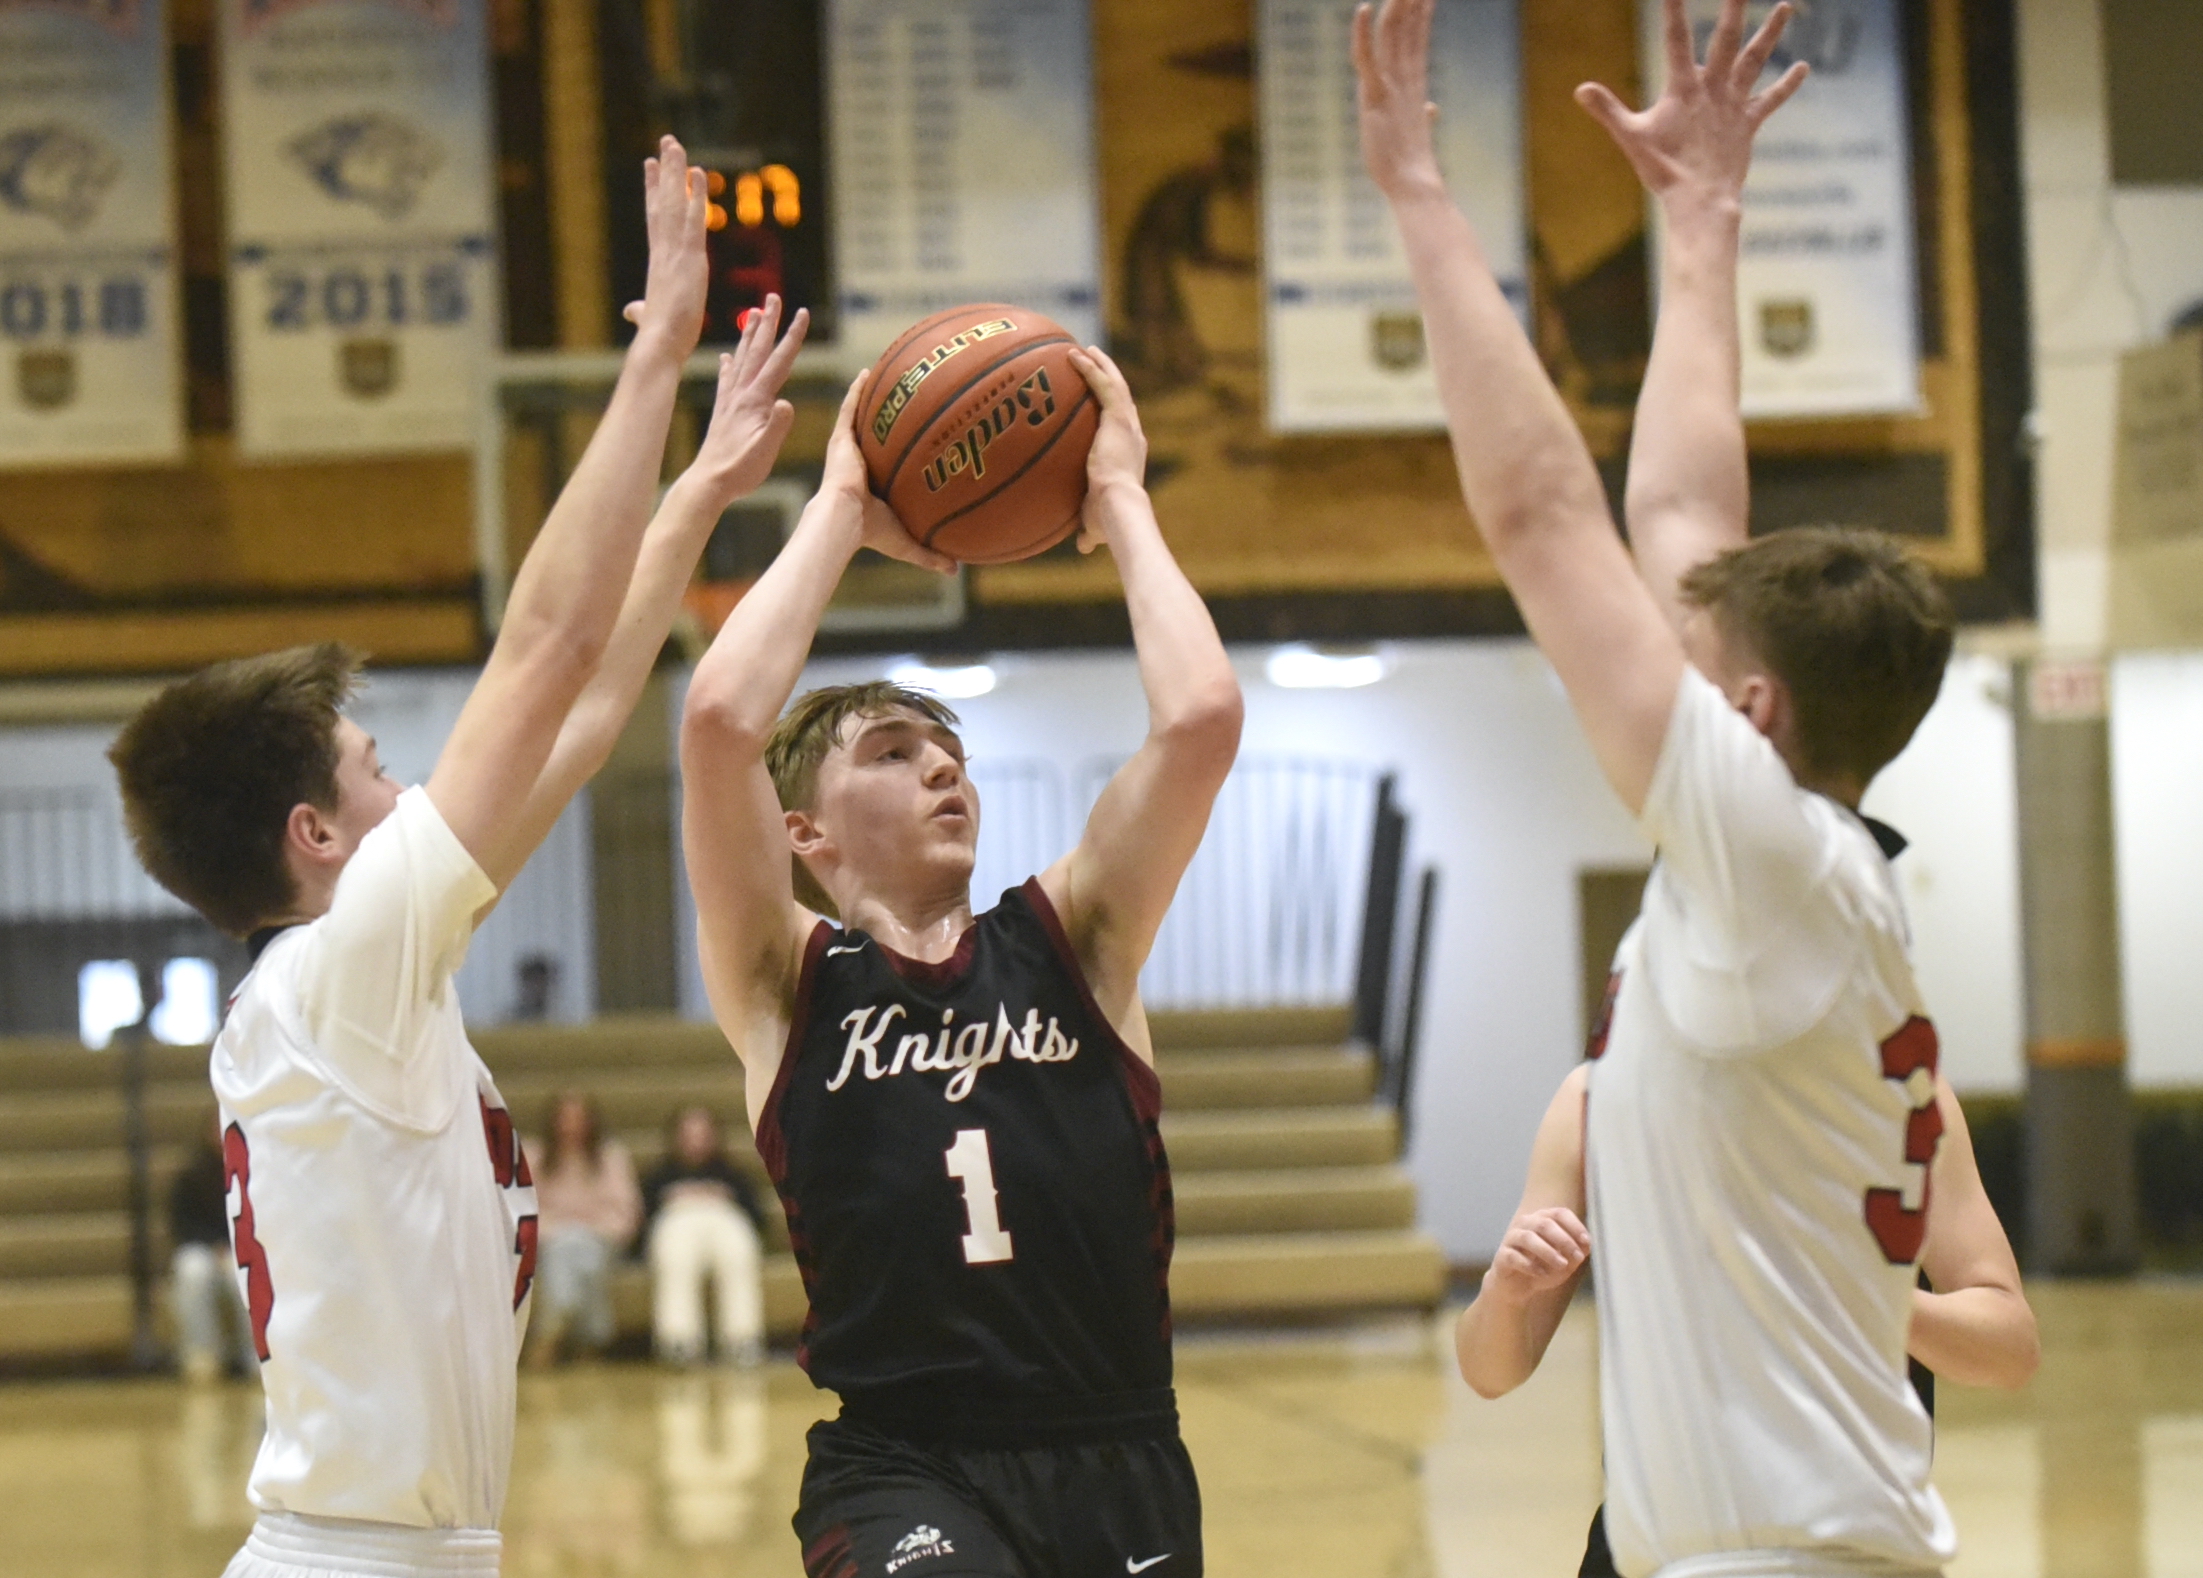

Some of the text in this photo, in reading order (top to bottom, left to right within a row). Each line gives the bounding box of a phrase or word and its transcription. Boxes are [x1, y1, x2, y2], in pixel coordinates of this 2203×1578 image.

[872, 317, 1018, 446] ELITE PRO
[922, 366, 1055, 492] Baden
[826, 1001, 1079, 1102] Knights
[945, 1128, 1014, 1264] 1
[885, 1540, 955, 1574] KNIGHTS
